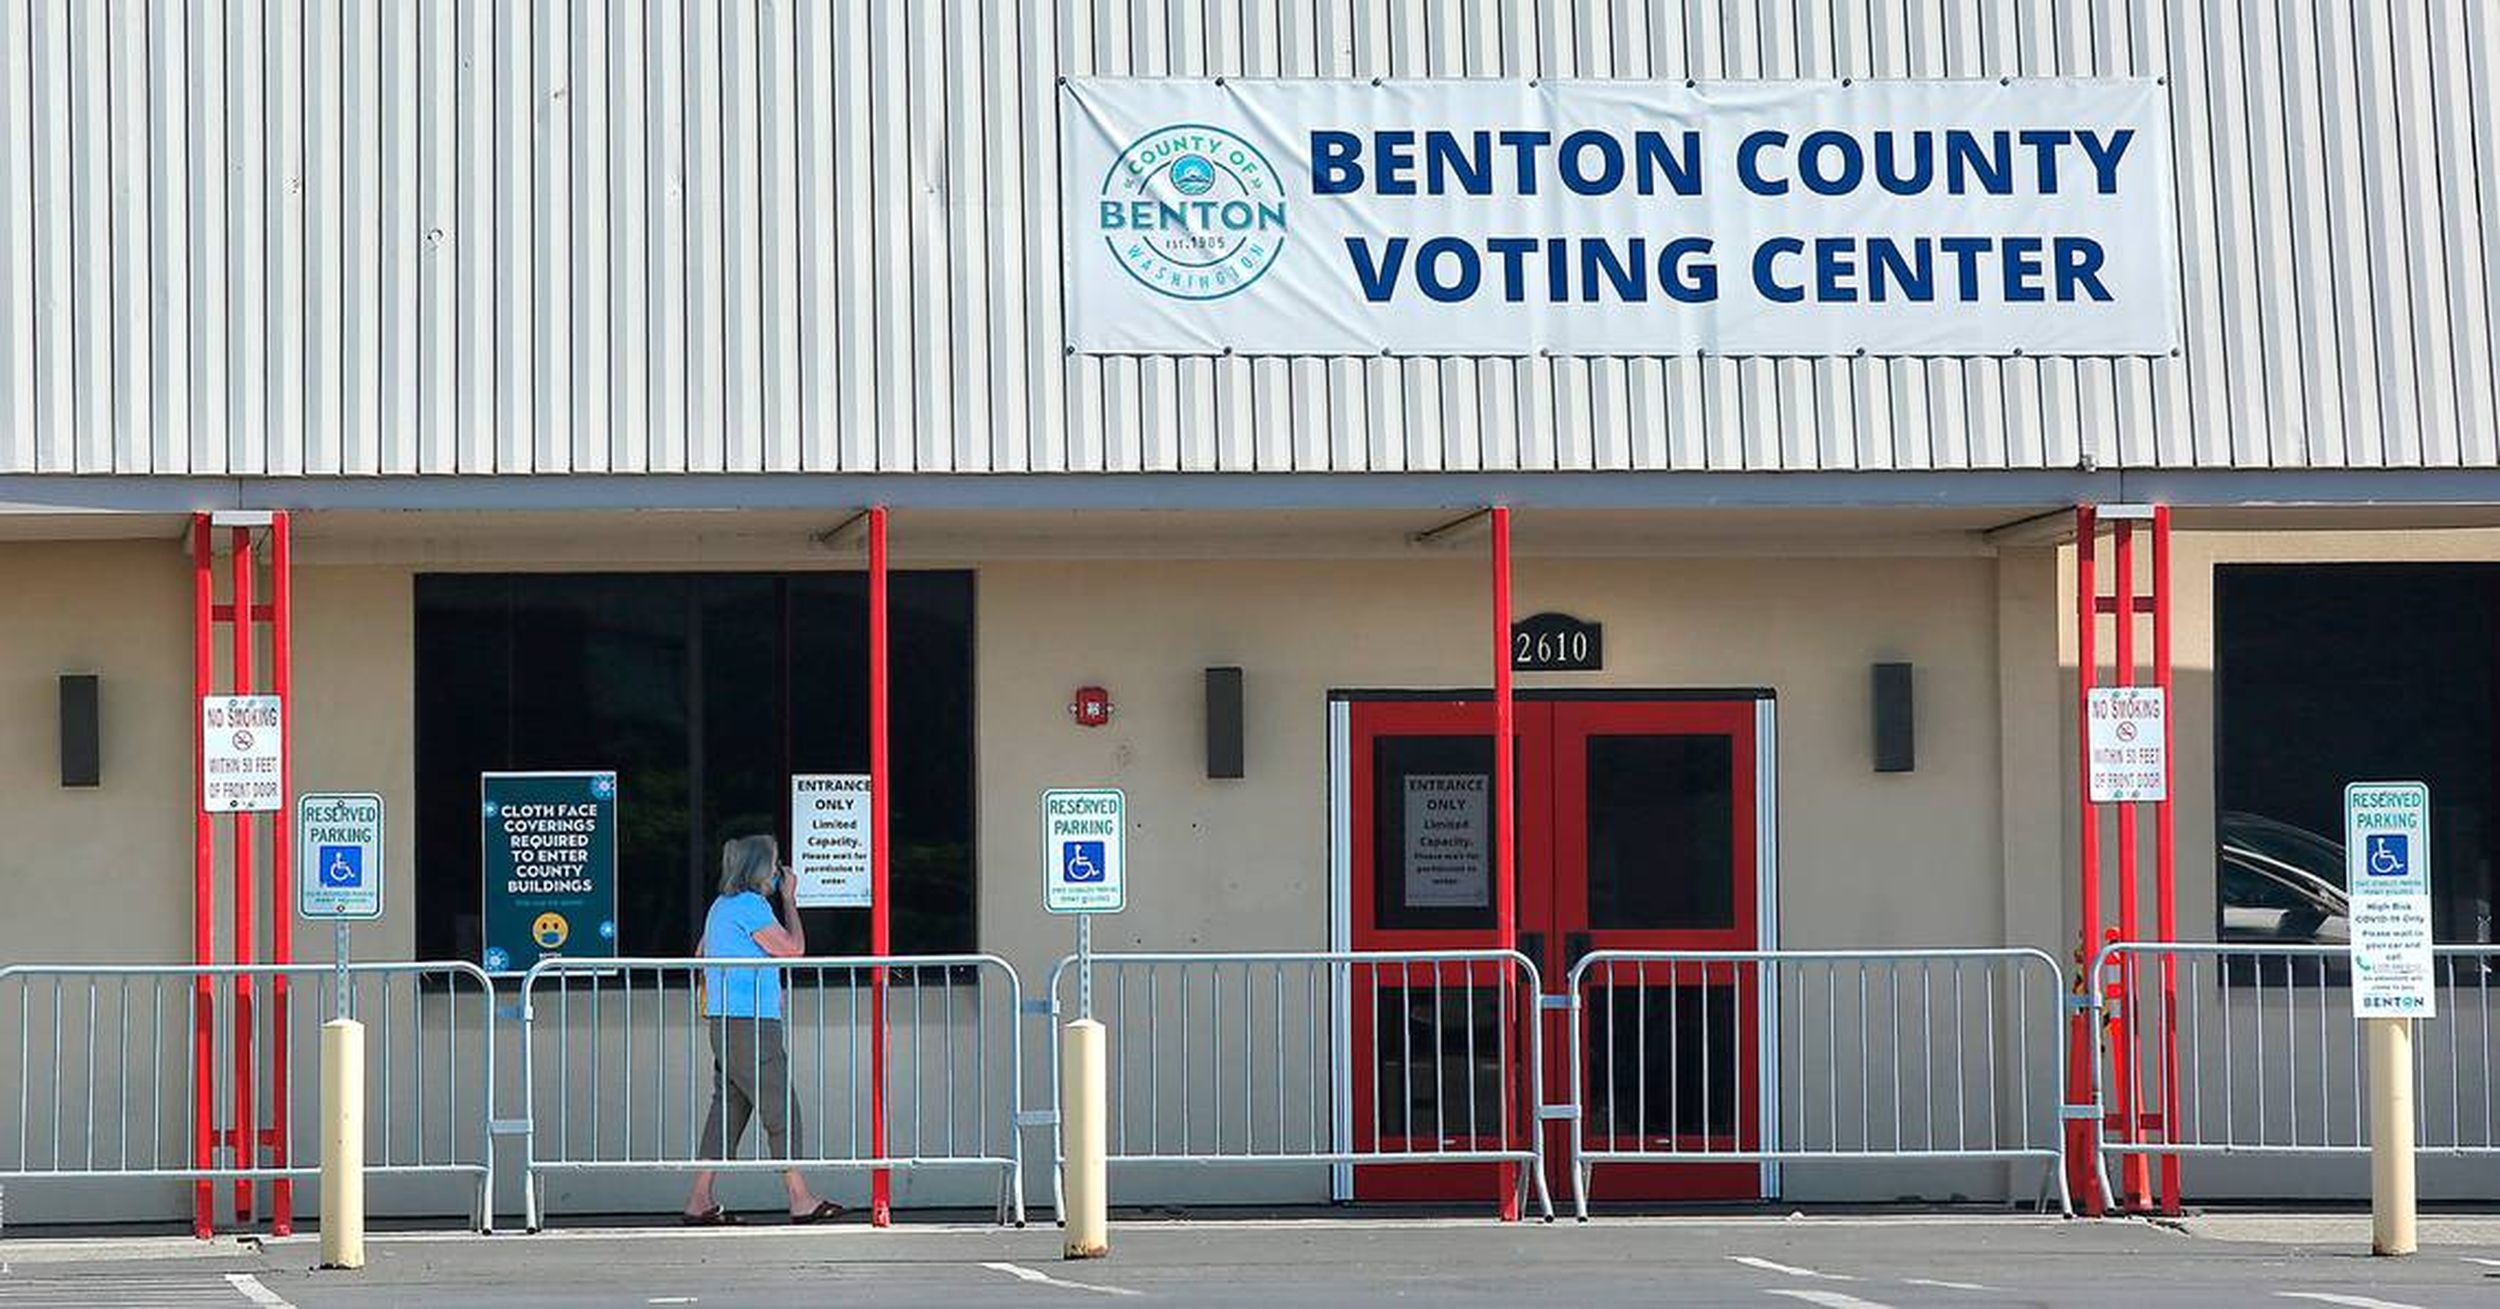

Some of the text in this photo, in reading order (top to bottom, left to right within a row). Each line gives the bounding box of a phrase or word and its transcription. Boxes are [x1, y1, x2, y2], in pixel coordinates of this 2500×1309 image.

[1128, 136, 1258, 175] COUNTY OF
[1310, 130, 2135, 196] BENTON COUNTY
[1101, 201, 1287, 230] BENTON
[1128, 242, 1264, 290] WASHINGTON
[1345, 237, 2115, 303] VOTING CENTER
[1517, 631, 1588, 662] 2610
[2093, 699, 2160, 719] NO SMOKING
[208, 707, 277, 728] NO SMOKING
[2139, 747, 2160, 764] FEET
[256, 757, 277, 772] FEET
[224, 782, 250, 798] FRONT
[254, 782, 277, 797] DOOR
[798, 780, 871, 791] ENTRANCE
[1409, 780, 1483, 790] ENTRANCE
[815, 799, 854, 810] ONLY
[1050, 799, 1117, 814] RESERVED
[1427, 799, 1466, 810] ONLY
[2353, 793, 2421, 808] RESERVED
[306, 807, 375, 822] RESERVED
[501, 804, 597, 818] CLOTH FACE
[504, 819, 595, 832] COVERINGS
[813, 820, 857, 829] Limited
[1054, 820, 1113, 835] PARKING
[2357, 813, 2417, 828] PARKING
[311, 828, 371, 843] PARKING
[510, 834, 589, 849] REQUIRED
[808, 837, 862, 848] Capacity.
[511, 850, 588, 862] TO ENTER
[516, 865, 584, 878] COUNTY
[507, 879, 592, 893] BUILDINGS
[2355, 915, 2400, 923] COVID-19
[2363, 997, 2424, 1008] BENTON
